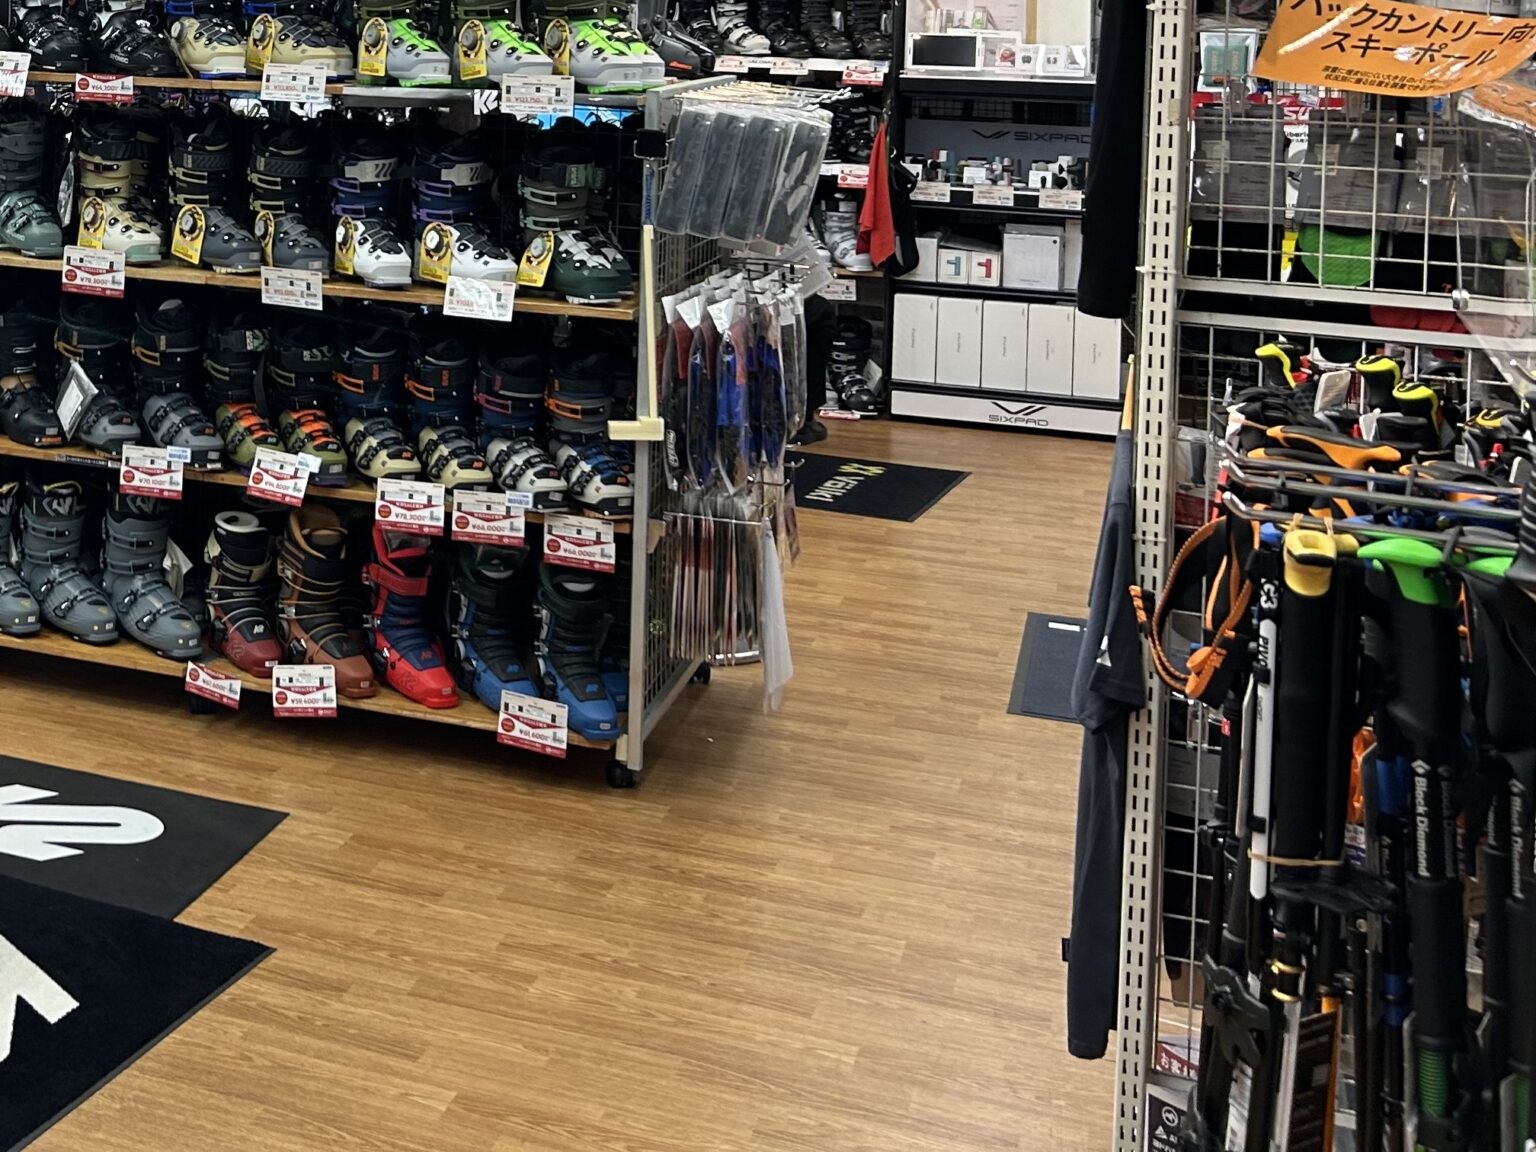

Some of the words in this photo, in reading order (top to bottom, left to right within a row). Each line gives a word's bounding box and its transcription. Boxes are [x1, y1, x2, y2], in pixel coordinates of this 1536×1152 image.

[1321, 30, 1497, 67] スキーポール
[988, 414, 1049, 426] SIXPAD
[1258, 634, 1269, 668] PIVO
[1414, 776, 1428, 815] Black
[1416, 816, 1431, 878] Diamond
